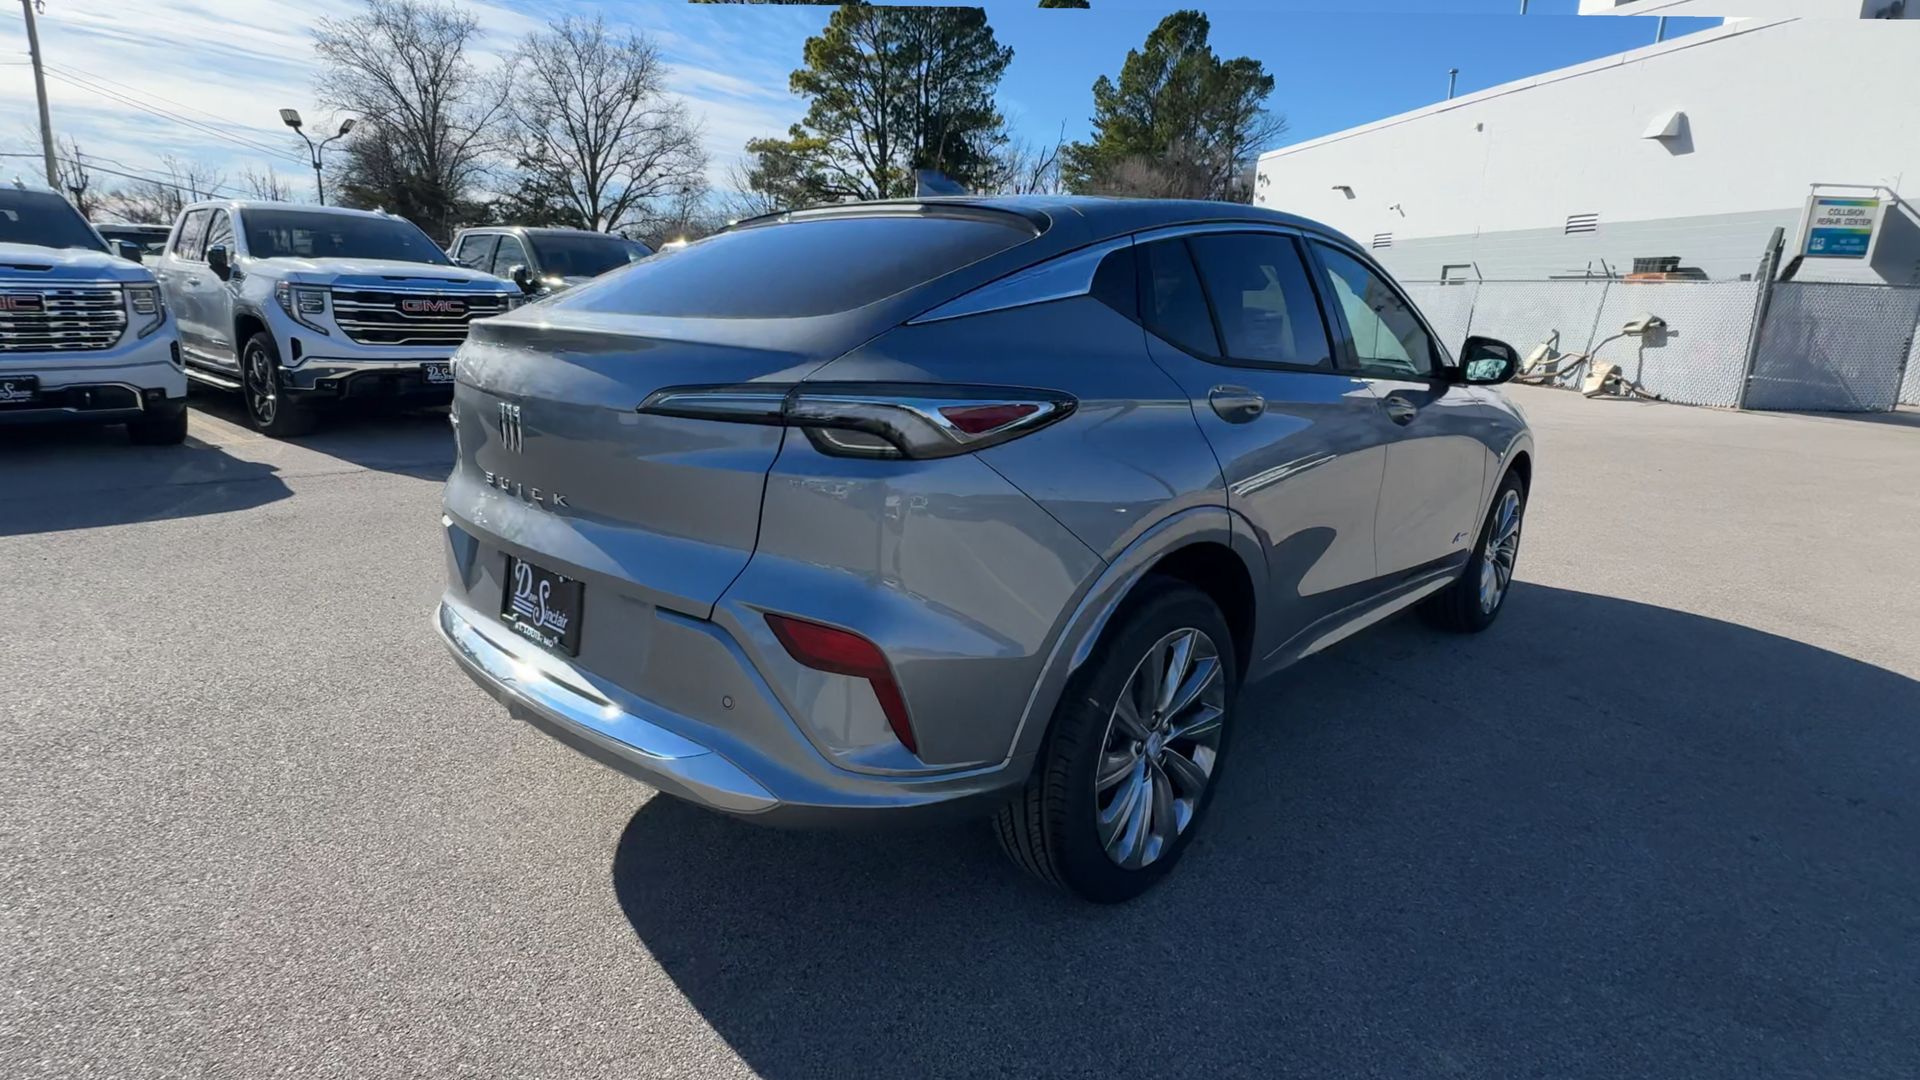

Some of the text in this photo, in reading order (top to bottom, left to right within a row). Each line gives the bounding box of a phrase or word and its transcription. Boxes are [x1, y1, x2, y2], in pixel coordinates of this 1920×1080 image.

[1828, 208, 1866, 216] COLLISION
[1817, 217, 1872, 226] REPAIR CENTER
[402, 299, 465, 313] GMC
[485, 471, 569, 508] BUICK
[532, 579, 568, 627] Sinclair
